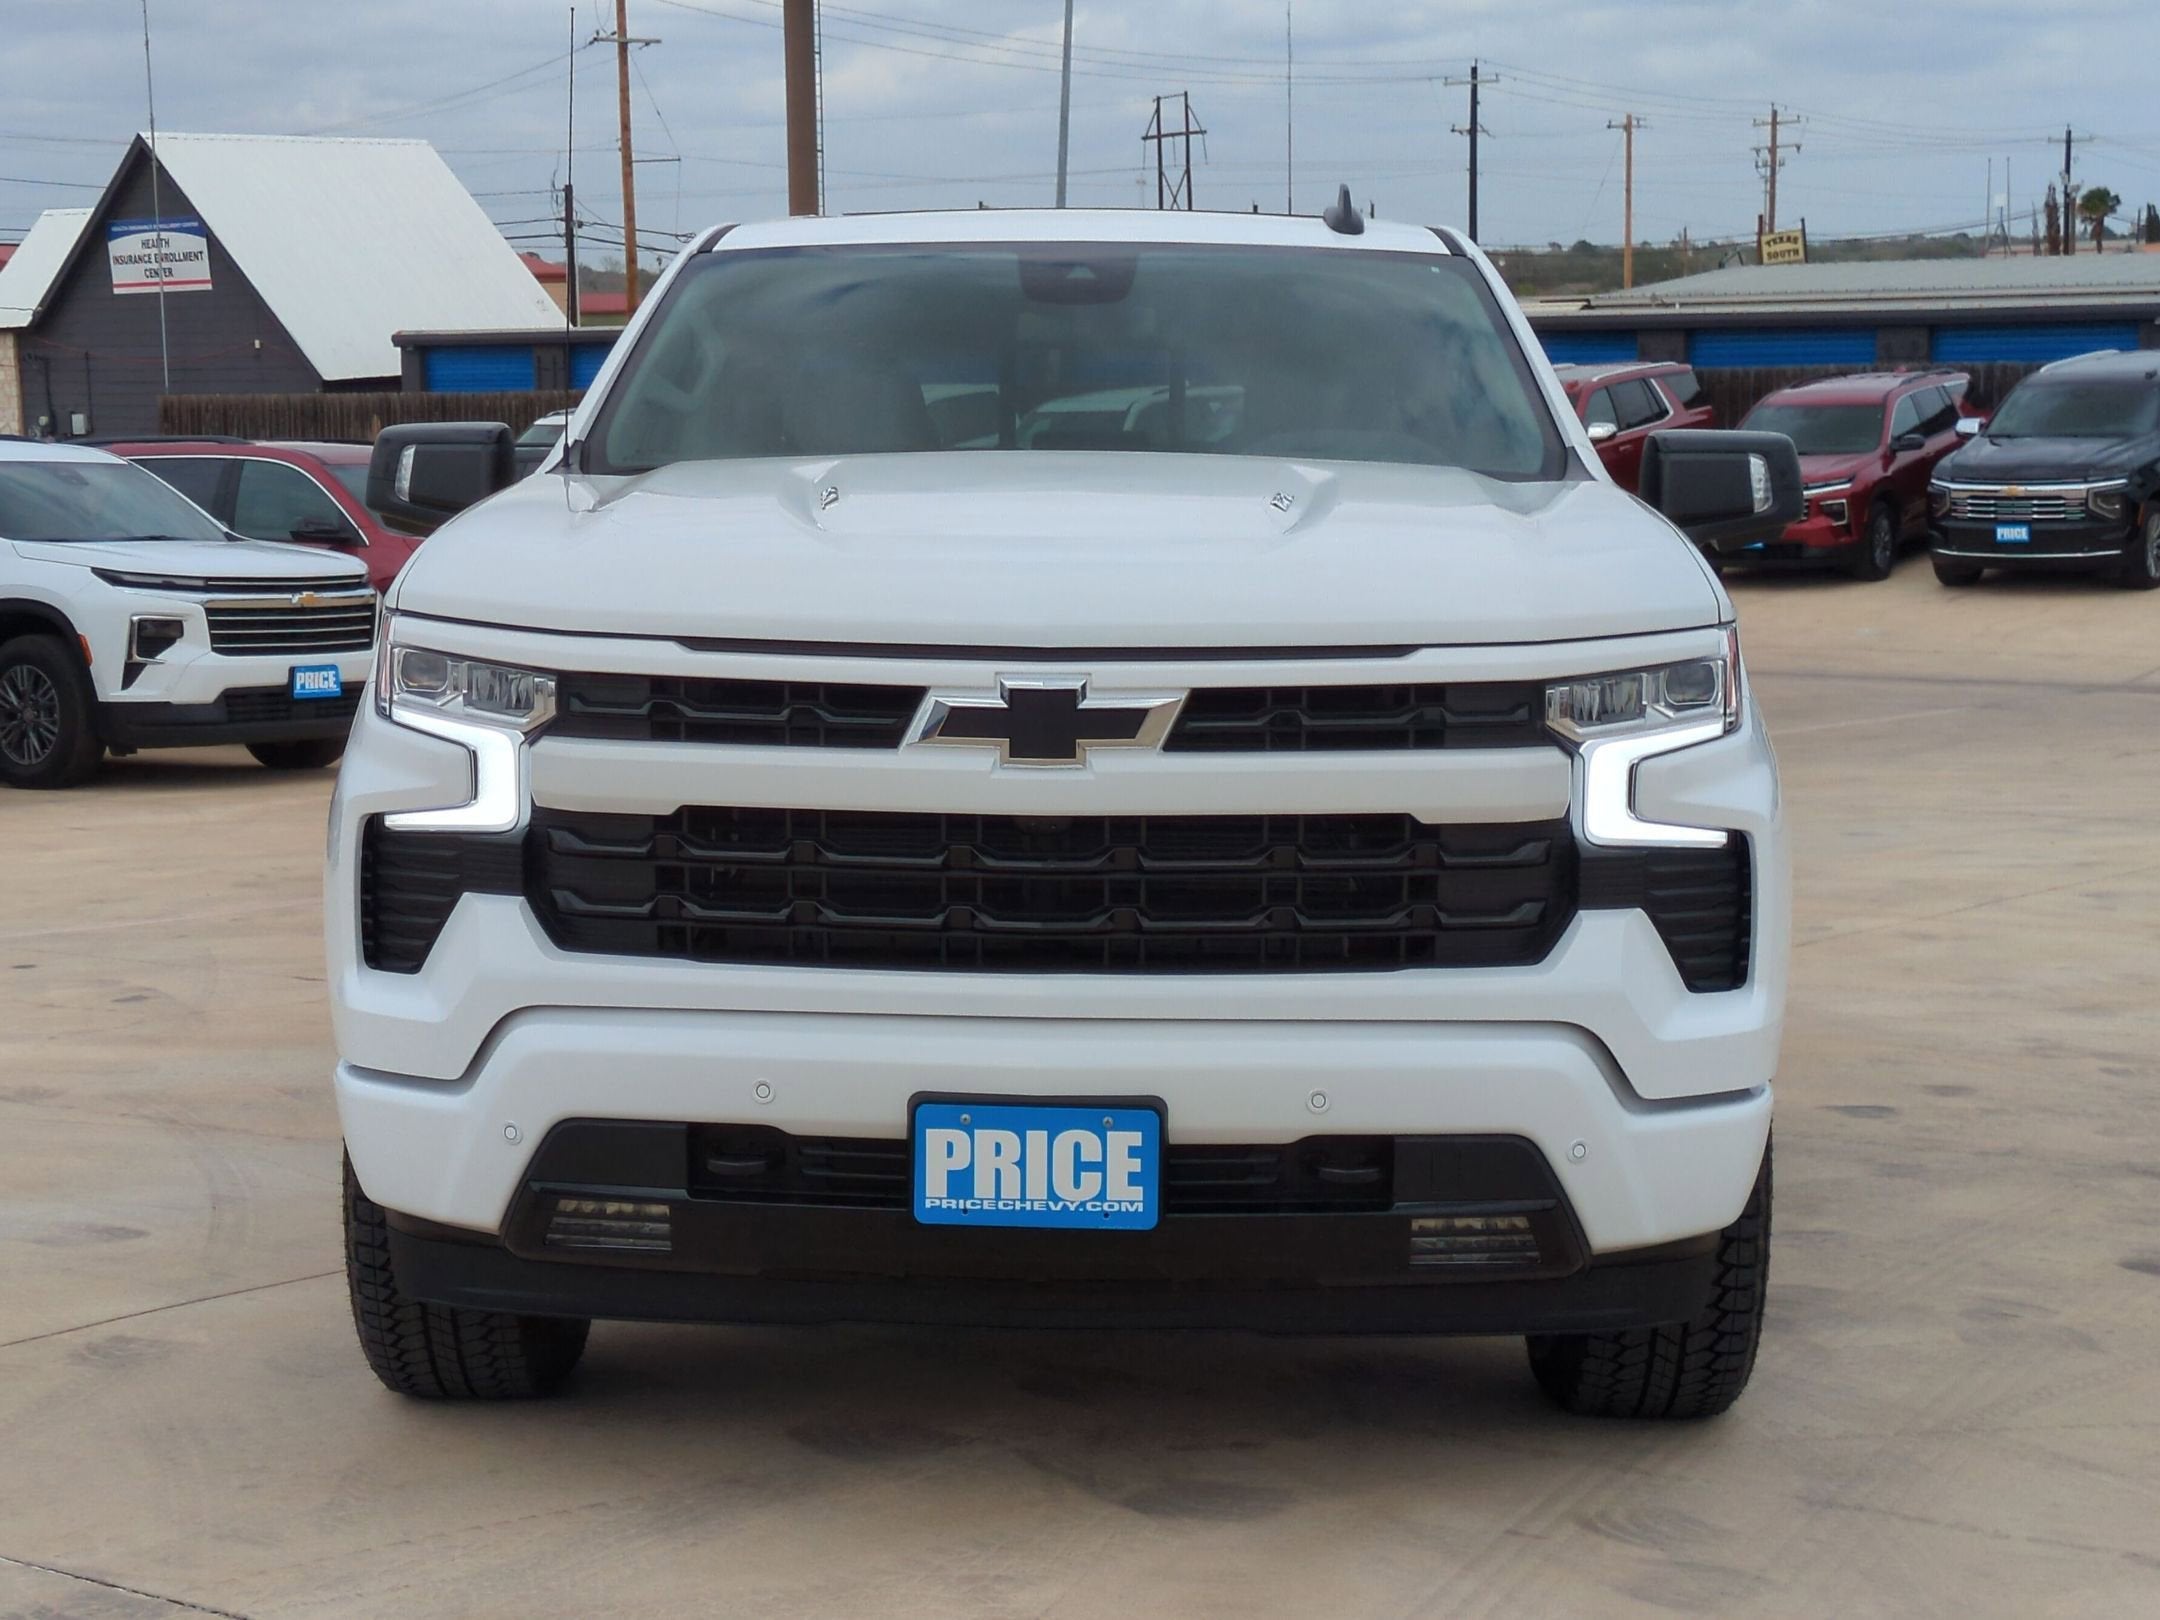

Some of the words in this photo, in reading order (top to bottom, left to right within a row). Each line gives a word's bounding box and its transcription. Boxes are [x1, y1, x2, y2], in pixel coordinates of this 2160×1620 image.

[1764, 235, 1799, 248] TEXAS
[112, 253, 152, 265] INSURANCE
[1766, 248, 1799, 260] SOUTH
[1996, 527, 2029, 540] PRICE
[296, 670, 337, 690] PRICE
[925, 1128, 1144, 1201] PRICE
[925, 1198, 1144, 1212] PRICECHEVY.COM
